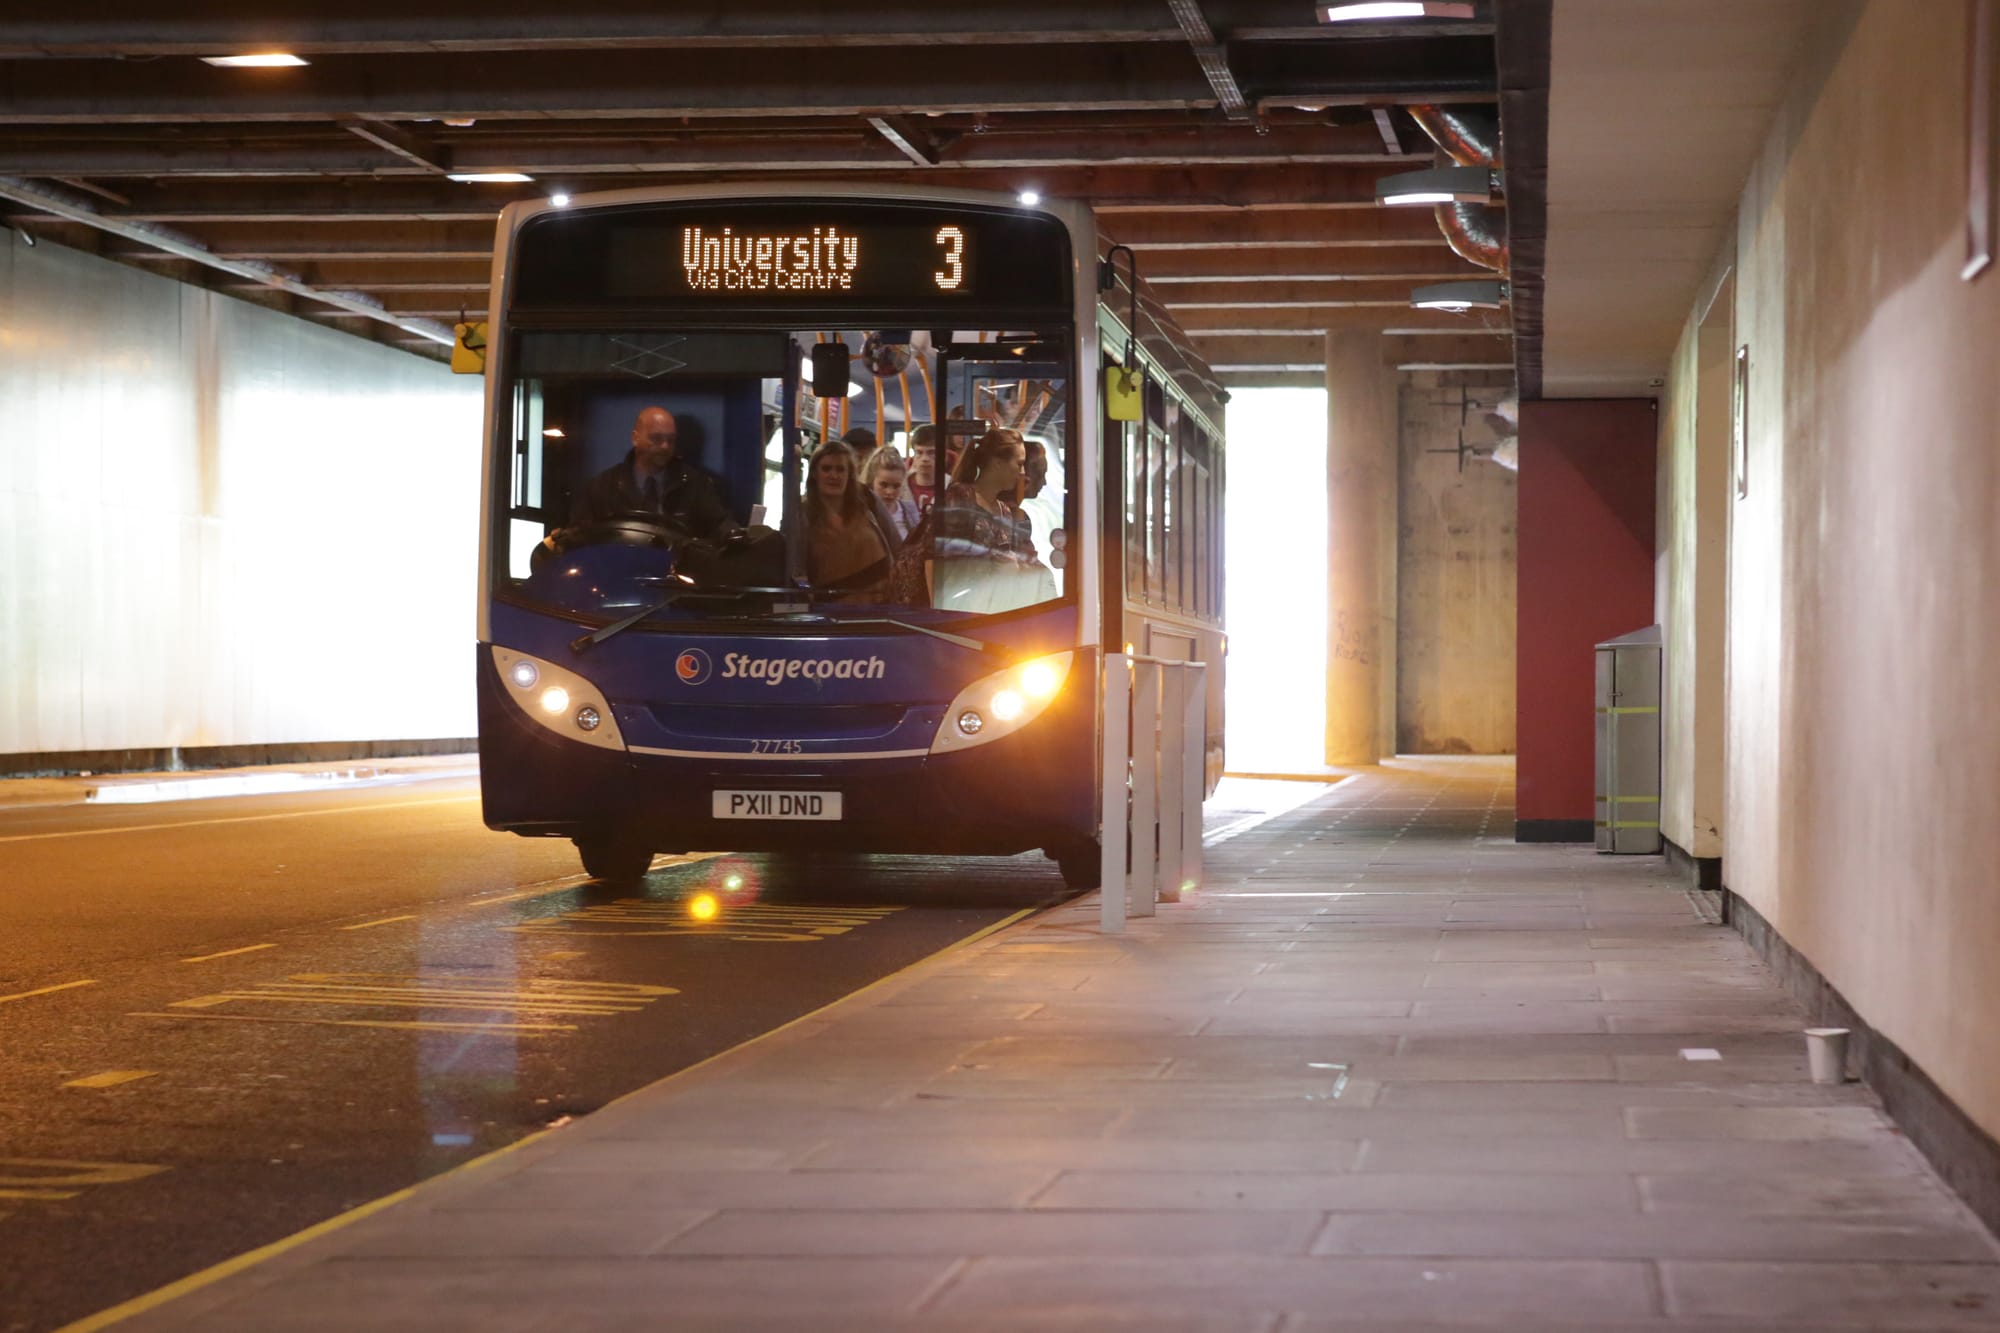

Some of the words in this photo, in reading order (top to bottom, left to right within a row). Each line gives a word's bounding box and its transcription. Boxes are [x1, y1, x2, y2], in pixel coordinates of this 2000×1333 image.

[683, 227, 858, 270] University
[935, 227, 963, 289] 3
[687, 269, 719, 289] Via
[724, 269, 769, 289] City
[775, 269, 851, 289] Centre
[721, 652, 886, 686] Stagecoach
[751, 739, 802, 754] 27745
[730, 794, 772, 815] PX11
[779, 795, 823, 816] DND
